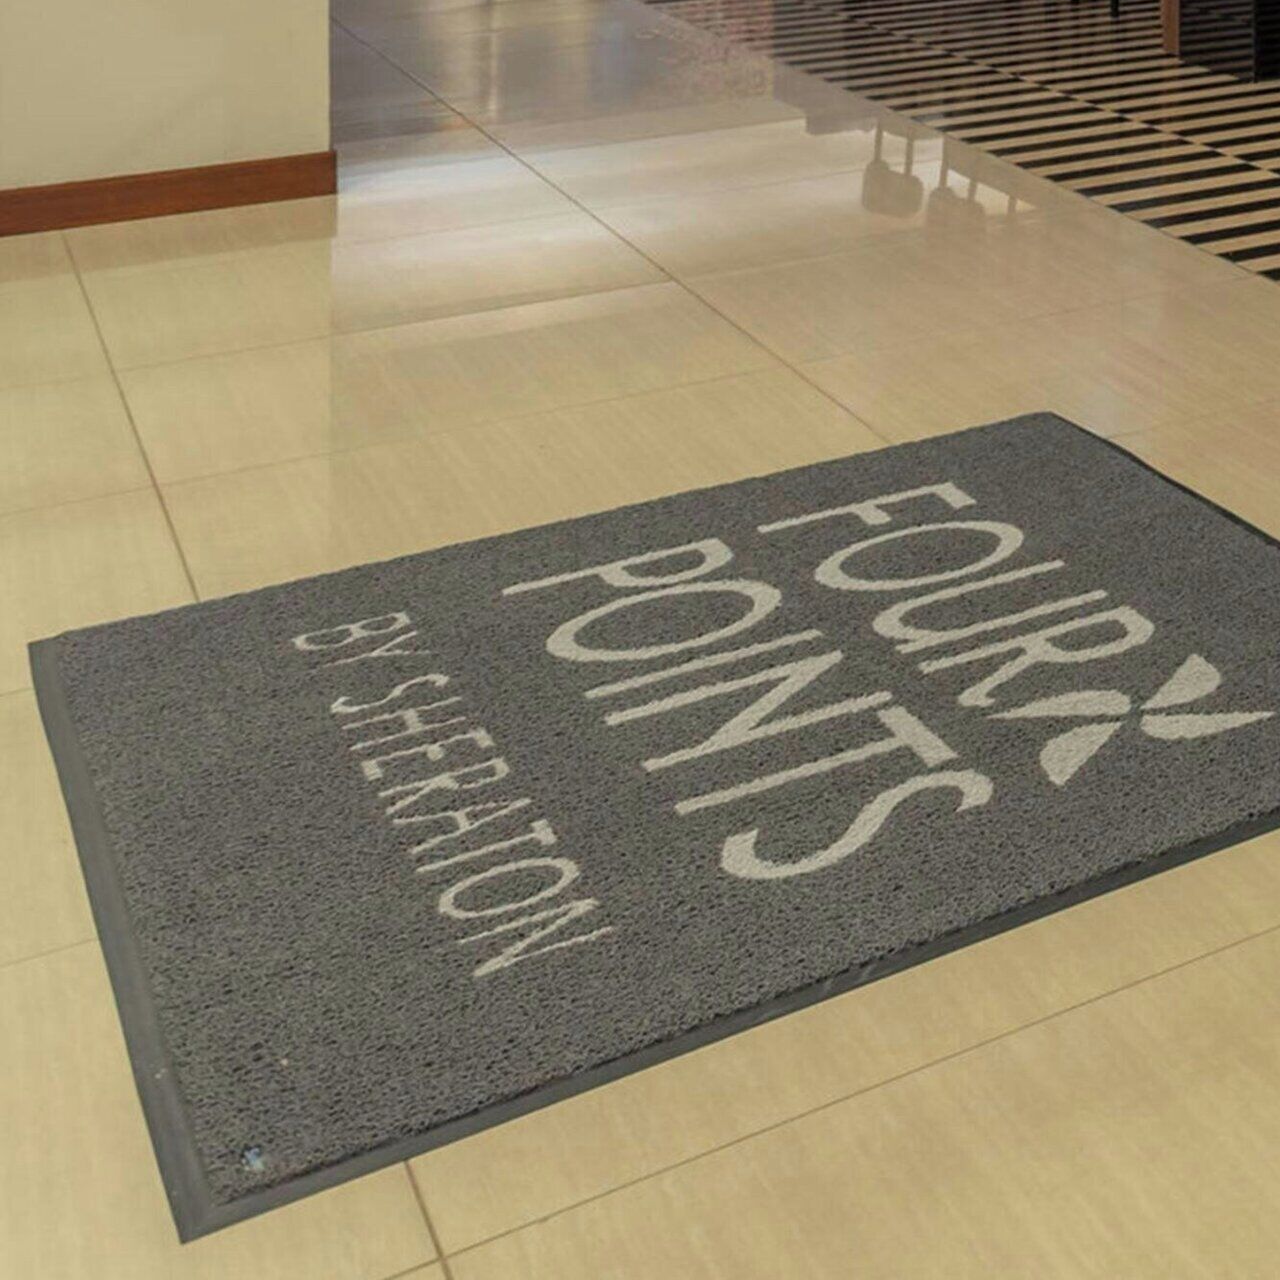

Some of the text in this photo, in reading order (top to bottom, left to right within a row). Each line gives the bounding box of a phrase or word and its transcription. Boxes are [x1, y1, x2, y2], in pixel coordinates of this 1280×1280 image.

[501, 537, 994, 881] POINTS
[757, 481, 1156, 708] FOUR
[291, 610, 614, 978] BY SHERATON
